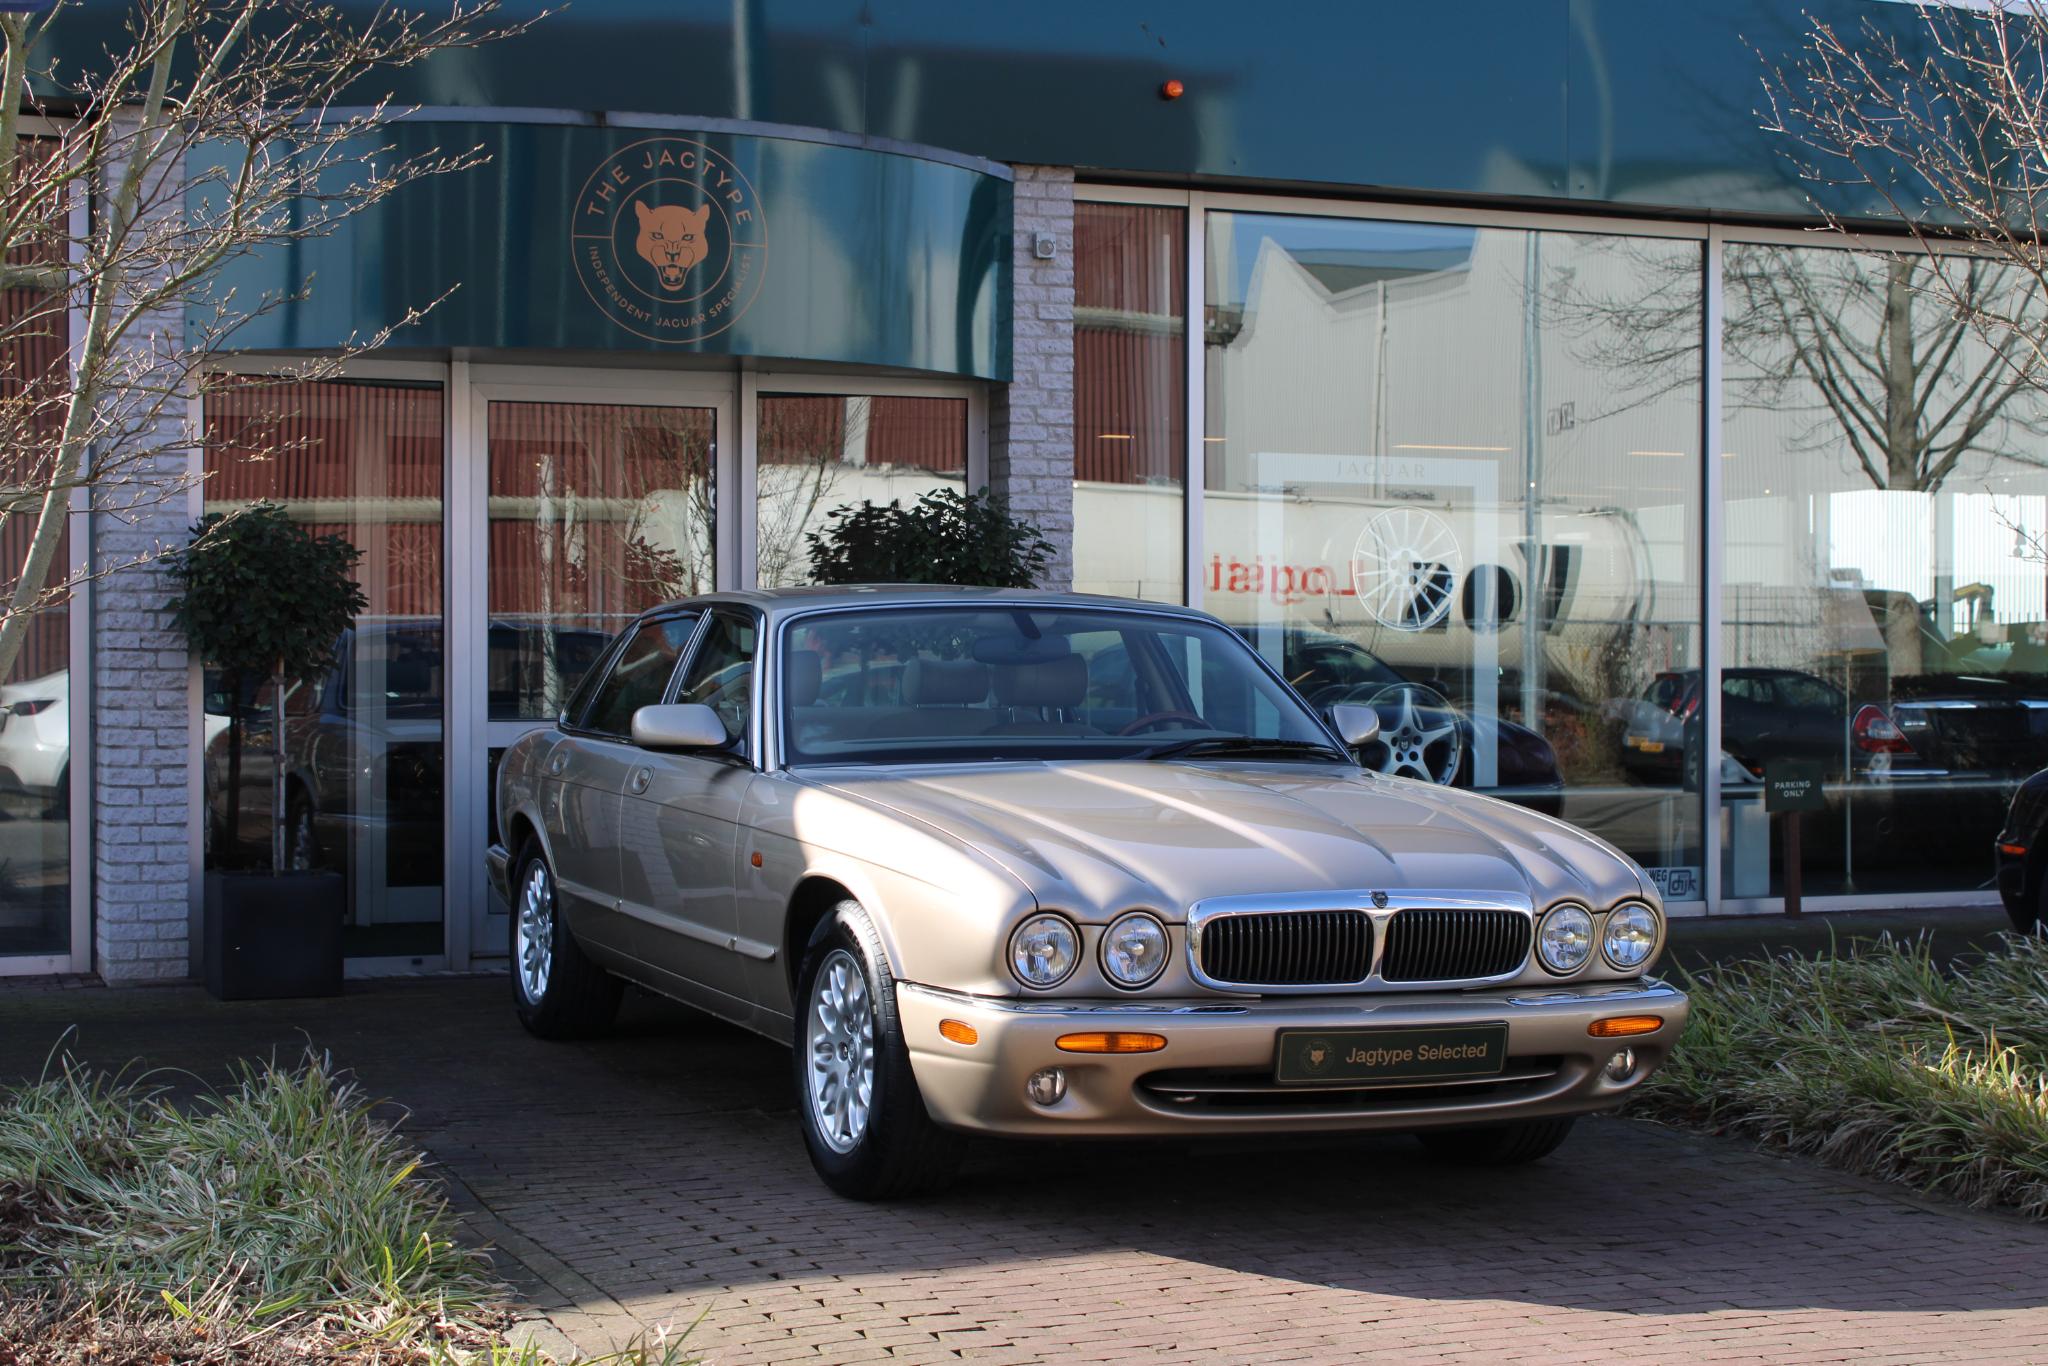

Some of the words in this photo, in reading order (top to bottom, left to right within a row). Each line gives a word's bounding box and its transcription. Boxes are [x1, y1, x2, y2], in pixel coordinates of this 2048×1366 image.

[587, 165, 630, 217] THE
[642, 149, 753, 225] JAGTYPE
[588, 246, 652, 322] INDEPENDENT
[655, 313, 706, 328] JAGUAR
[709, 253, 753, 317] SPECIALIST
[1335, 461, 1425, 478] JAGUAR
[1774, 780, 1811, 790] PARKING
[1783, 790, 1805, 798] ONLY
[1346, 1047, 1413, 1066] Jagtype
[1417, 1042, 1487, 1061] Selected
